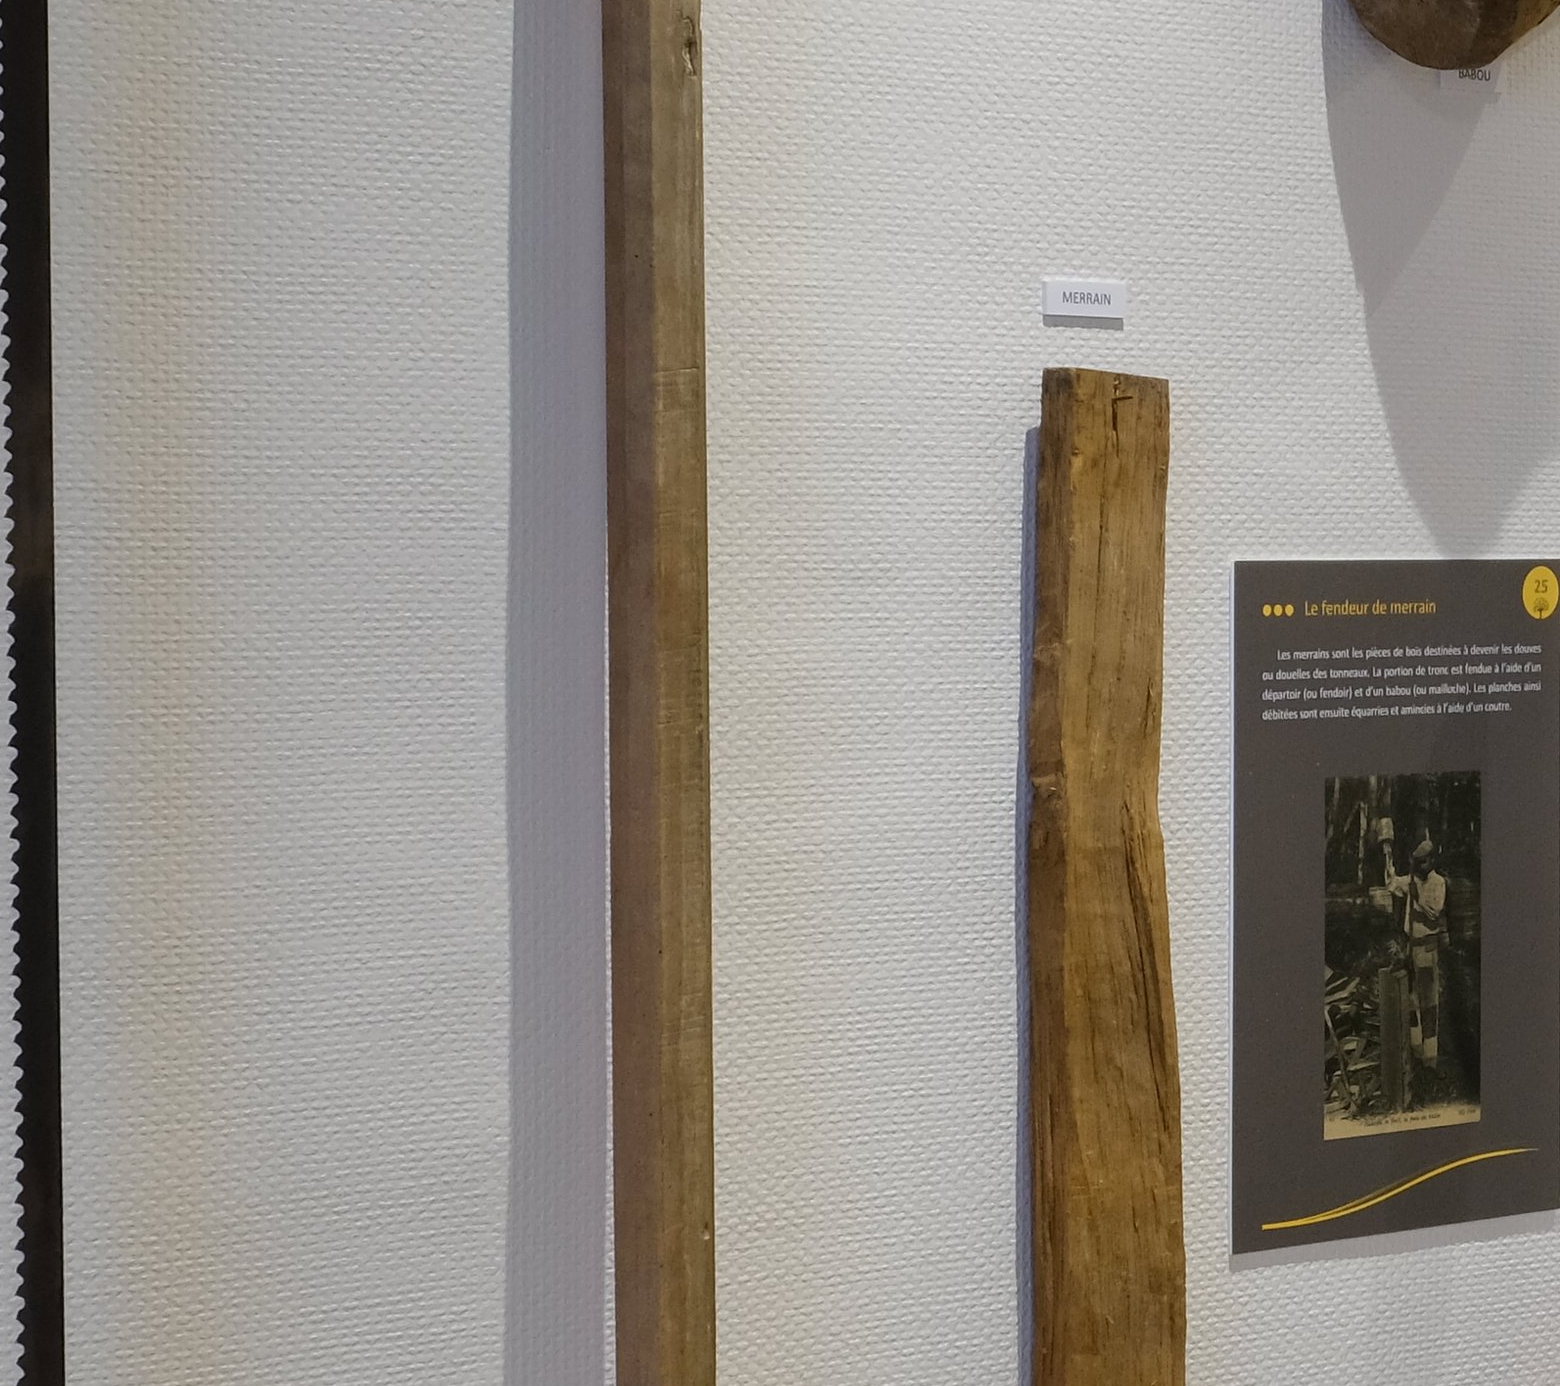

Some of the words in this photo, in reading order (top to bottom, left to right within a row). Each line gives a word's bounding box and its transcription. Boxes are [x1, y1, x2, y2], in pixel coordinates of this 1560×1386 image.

[1458, 69, 1491, 81] BABOU
[1062, 291, 1111, 306] MERRAIN
[1534, 579, 1549, 594] 25
[1305, 601, 1318, 616] Le
[1322, 600, 1368, 615] fendeur
[1372, 599, 1386, 615] de
[1391, 600, 1435, 613] merrain
[1278, 650, 1291, 660] Les
[1293, 648, 1329, 660] merrains
[1332, 649, 1349, 658] sont
[1352, 647, 1363, 658] les
[1366, 647, 1391, 659] pièces
[1406, 646, 1422, 656] bois
[1424, 645, 1461, 656] destinées
[1471, 645, 1499, 654] devenir
[1502, 644, 1512, 653] les
[1514, 644, 1541, 653] douves
[1276, 669, 1310, 679] douelles
[1313, 668, 1327, 678] des
[1330, 668, 1369, 678] tonneaux.
[1384, 667, 1413, 679] portion
[1428, 666, 1448, 675] tronc
[1451, 666, 1462, 675] est
[1465, 663, 1492, 674] fendue
[1262, 689, 1300, 703] départoir
[1304, 688, 1317, 700] (ou
[1320, 686, 1352, 700] fendoir)
[1386, 685, 1411, 696] babou
[1413, 685, 1426, 696] (ou
[1474, 683, 1486, 693] Les
[1489, 681, 1521, 693] planches
[1524, 683, 1541, 691] ainsi
[1300, 709, 1317, 719] sont
[1320, 707, 1349, 718] ensuite
[1485, 702, 1511, 711] coutre.
